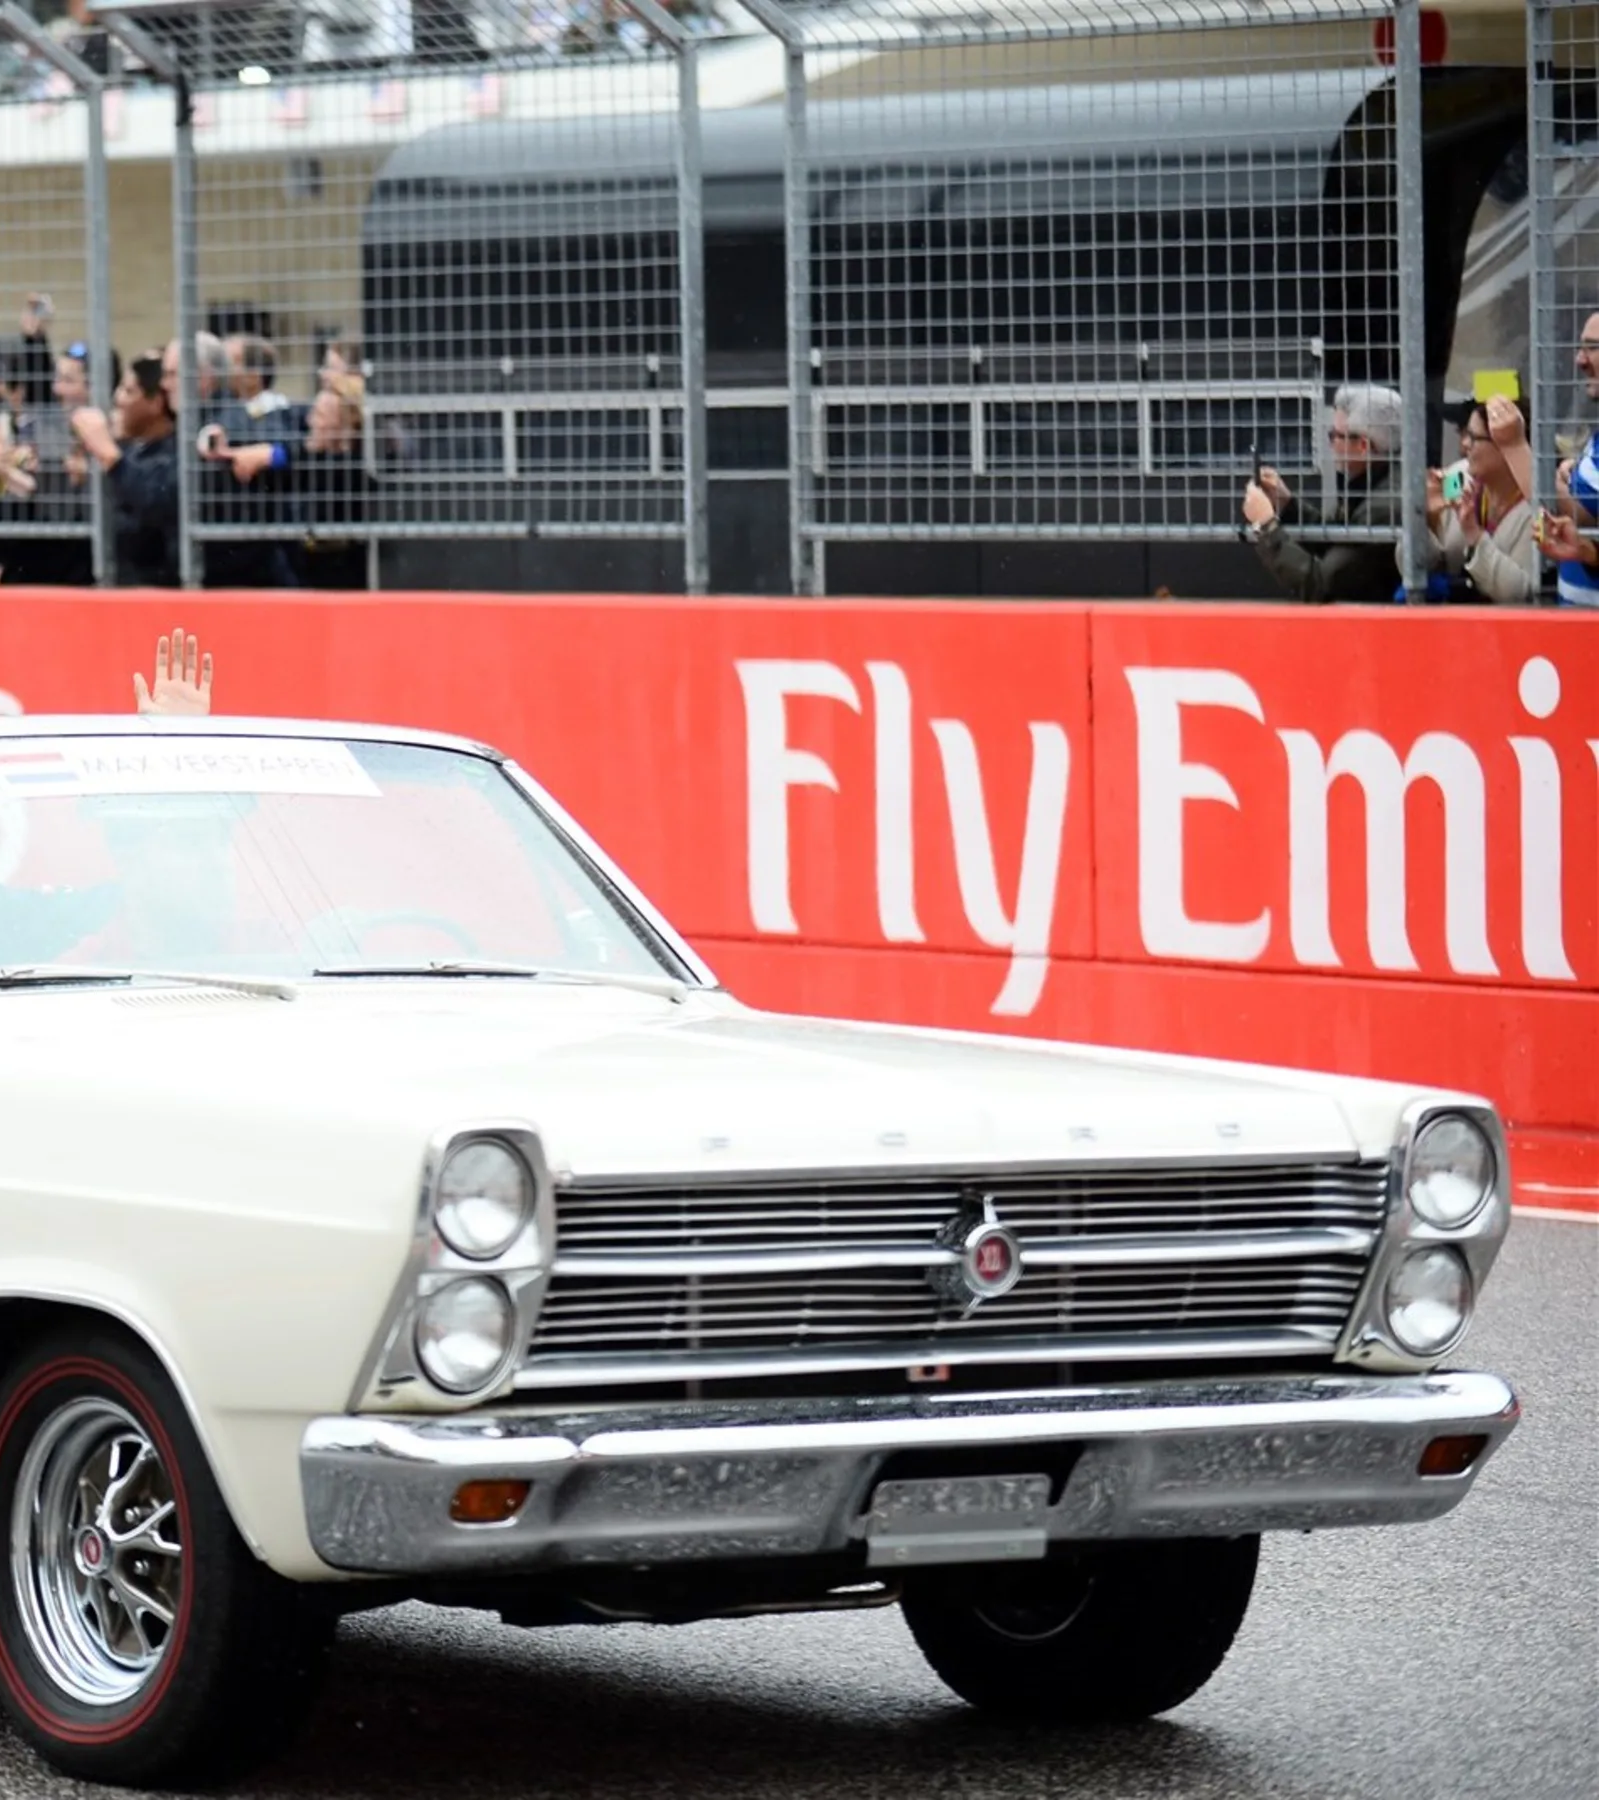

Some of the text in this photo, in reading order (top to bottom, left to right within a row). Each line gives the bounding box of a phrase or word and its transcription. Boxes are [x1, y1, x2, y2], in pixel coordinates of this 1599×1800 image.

[82, 757, 149, 775] MAX
[736, 656, 1599, 1015] Fly Emi
